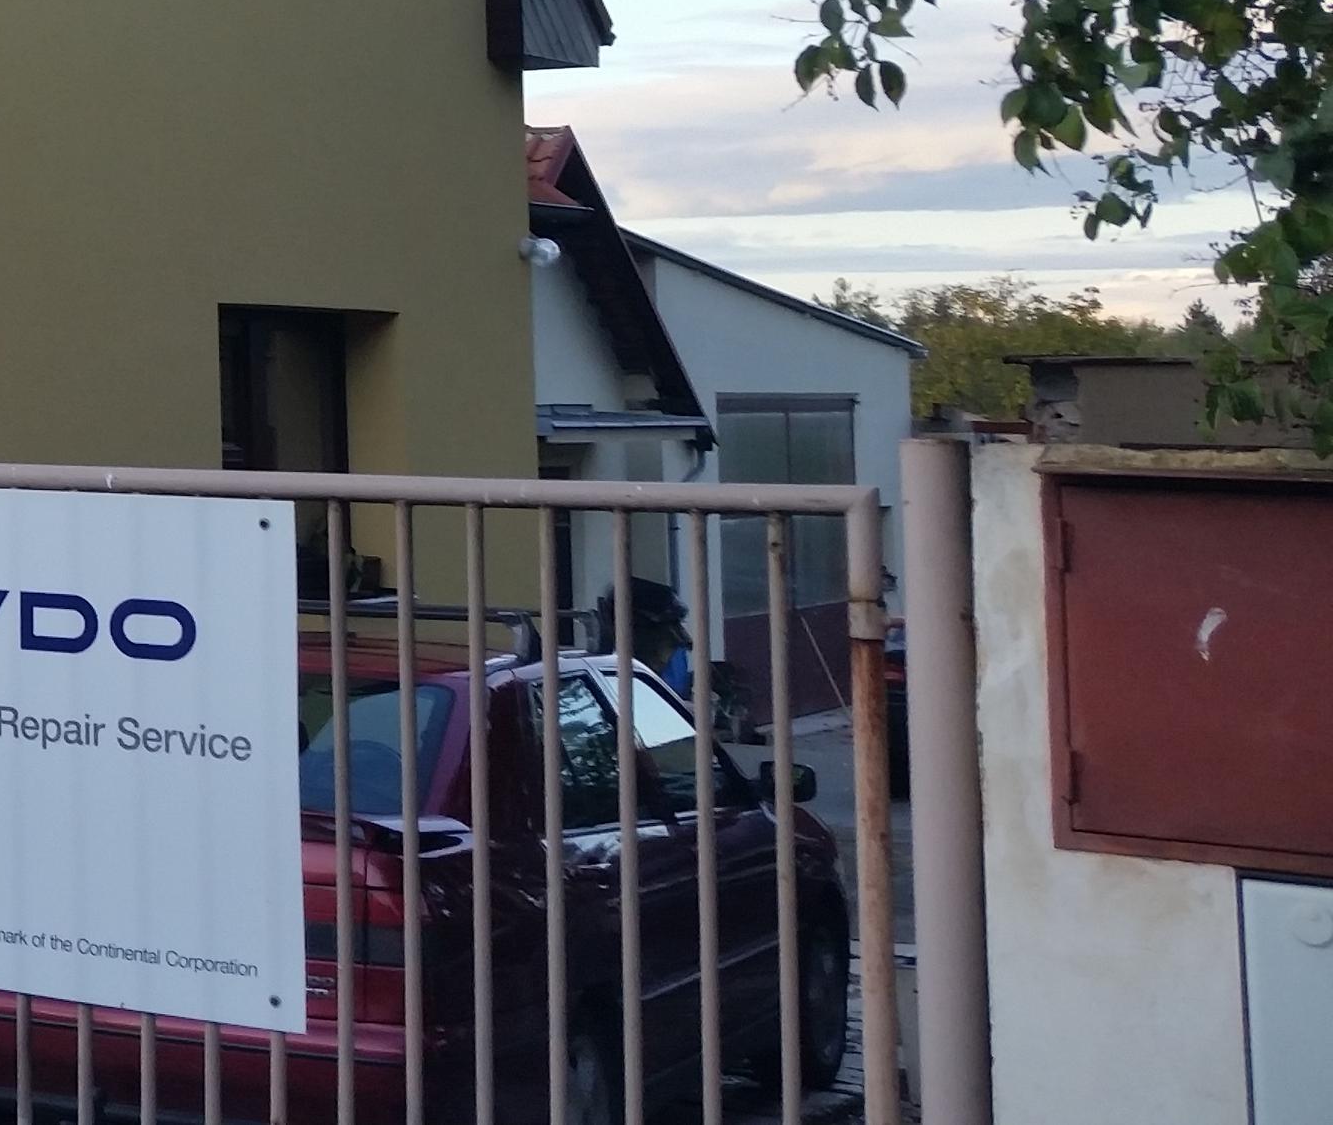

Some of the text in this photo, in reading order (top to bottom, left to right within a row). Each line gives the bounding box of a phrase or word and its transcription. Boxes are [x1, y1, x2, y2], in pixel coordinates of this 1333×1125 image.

[116, 715, 253, 762] Service
[31, 931, 46, 949] of
[50, 935, 73, 953] the
[76, 937, 162, 966] Continental
[165, 950, 259, 978] Corporation
